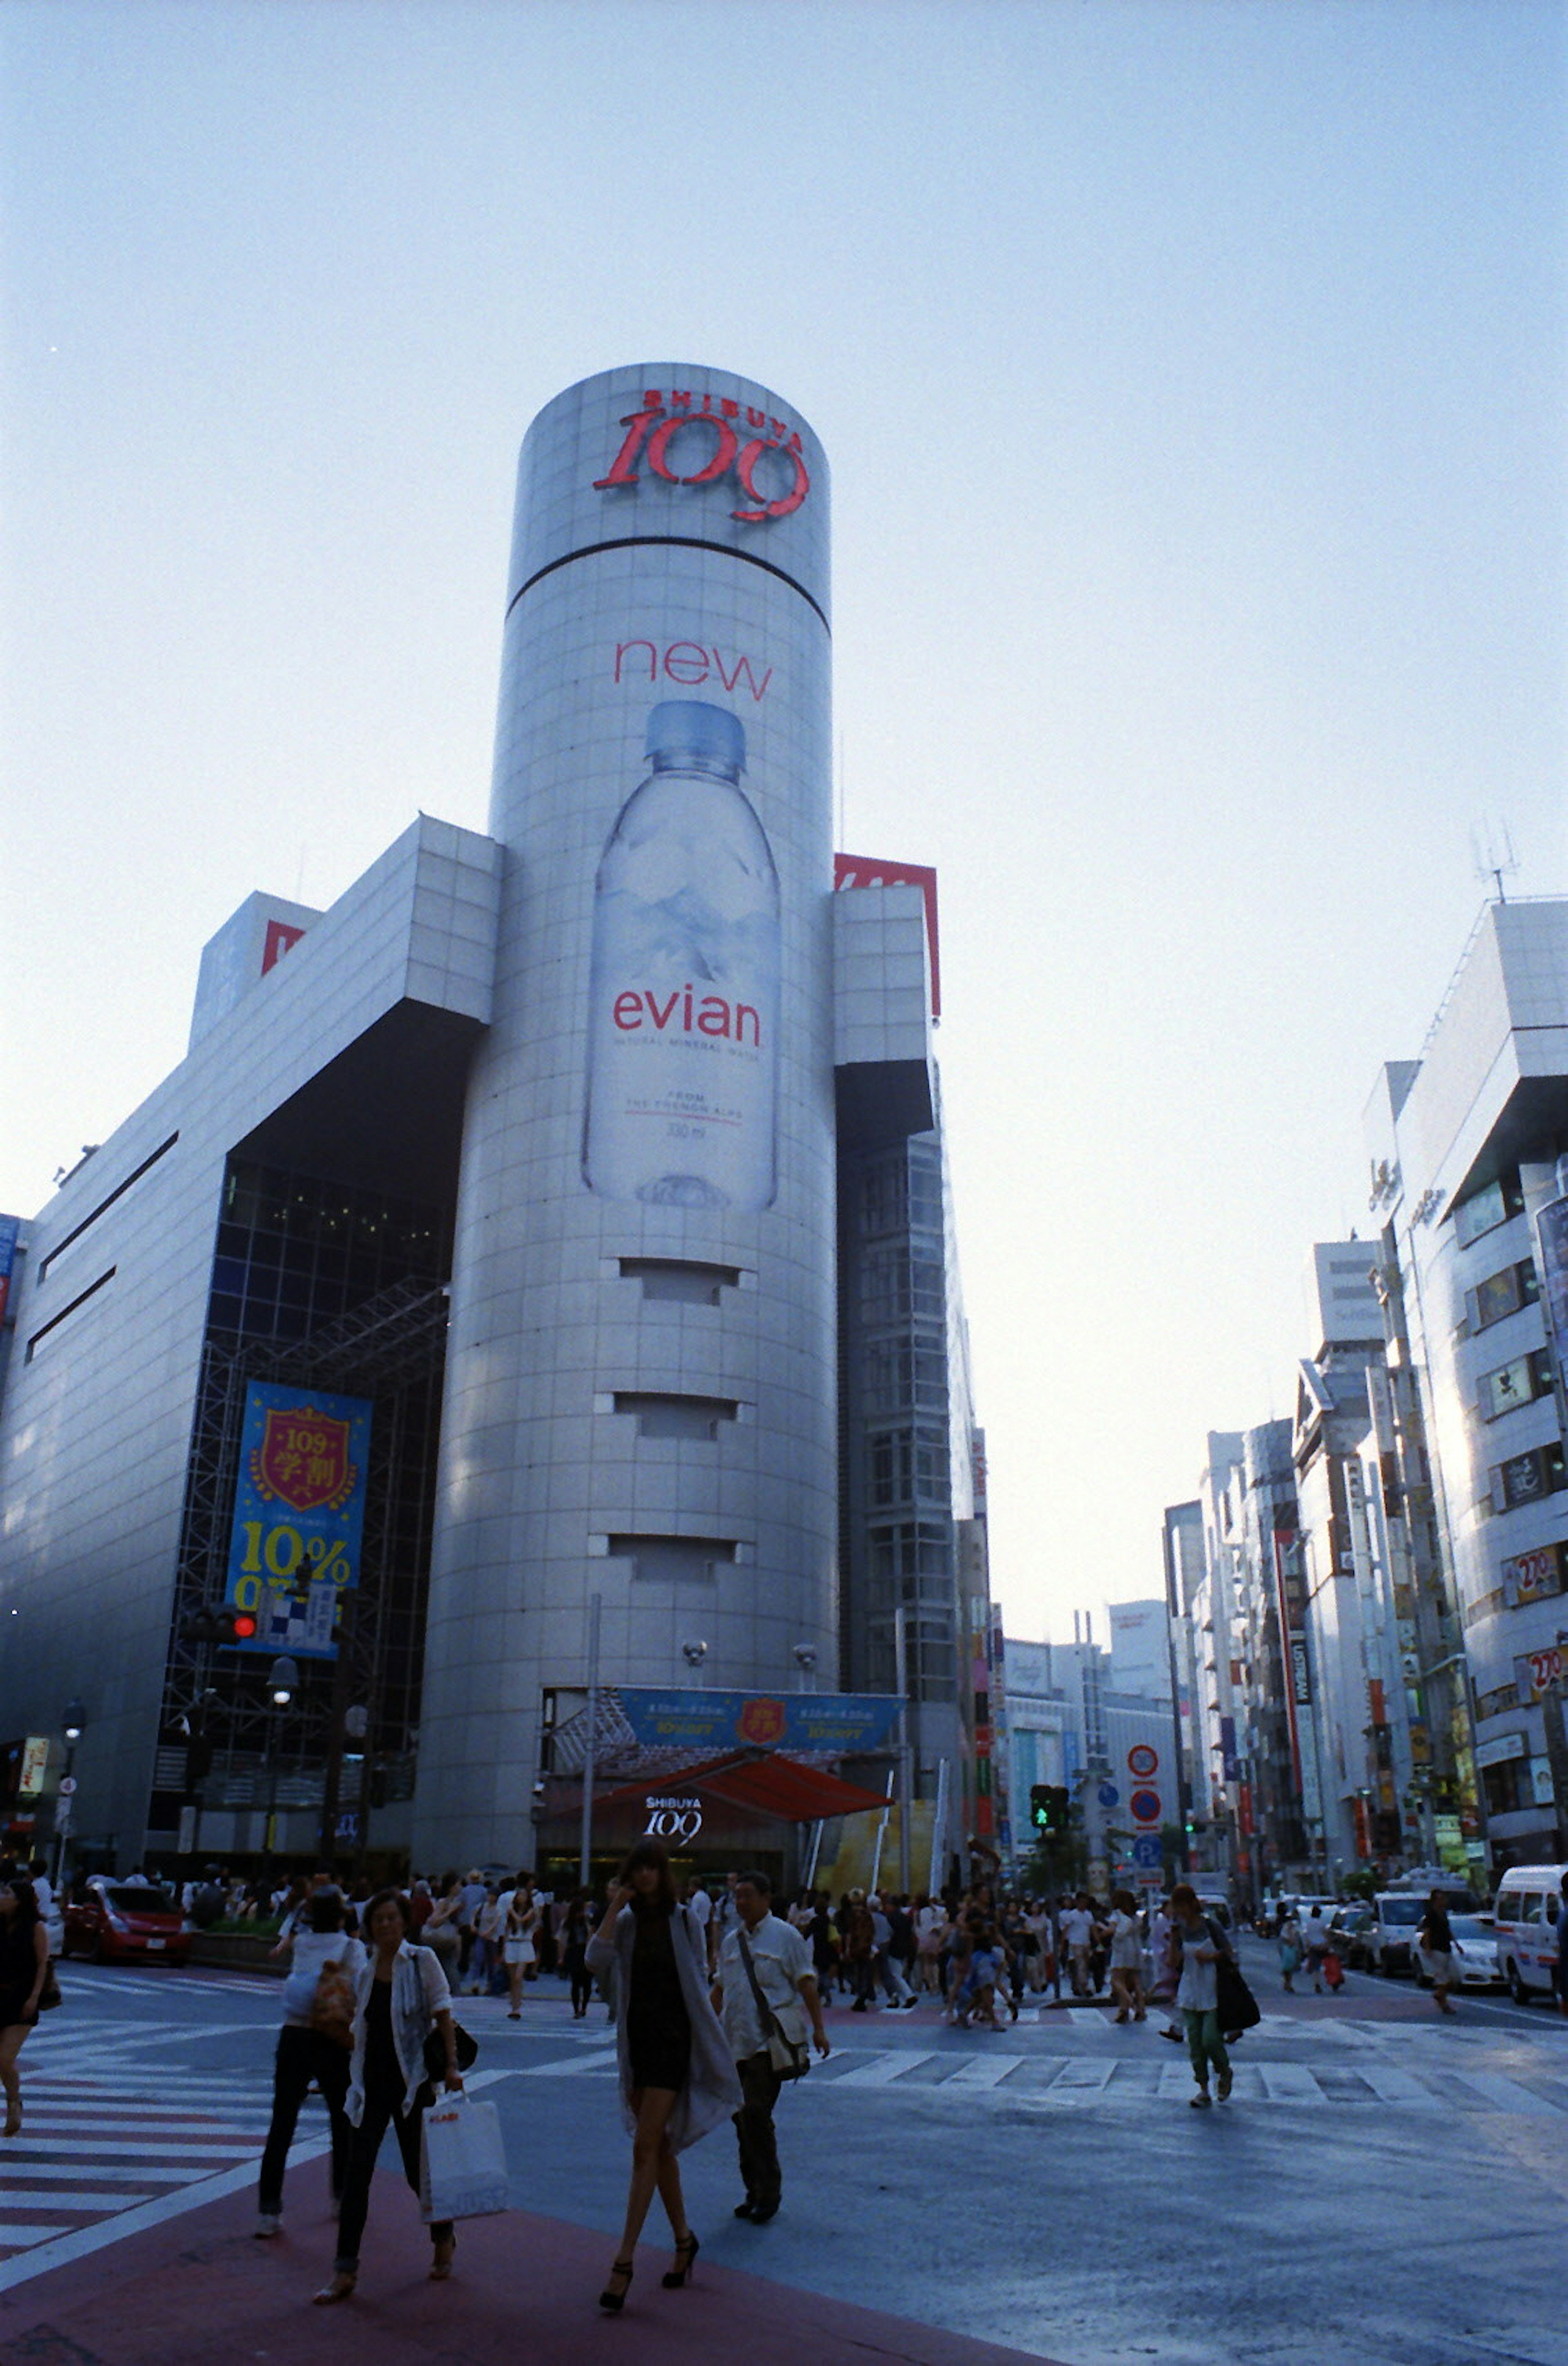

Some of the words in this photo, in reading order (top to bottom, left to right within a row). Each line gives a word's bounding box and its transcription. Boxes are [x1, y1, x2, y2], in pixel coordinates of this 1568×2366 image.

[643, 390, 803, 453] SHIBUYA
[592, 408, 810, 522] 109
[614, 639, 773, 701] new
[613, 983, 760, 1047] evian
[669, 1038, 721, 1053] MINERAL
[668, 1091, 705, 1102] FROM
[287, 1428, 327, 1456] 109
[241, 1520, 351, 1584] 10%
[1519, 1552, 1548, 1588] 270
[1531, 1650, 1561, 1687] 270
[645, 1796, 702, 1810] SHIBUYA
[642, 1809, 702, 1847] 109
